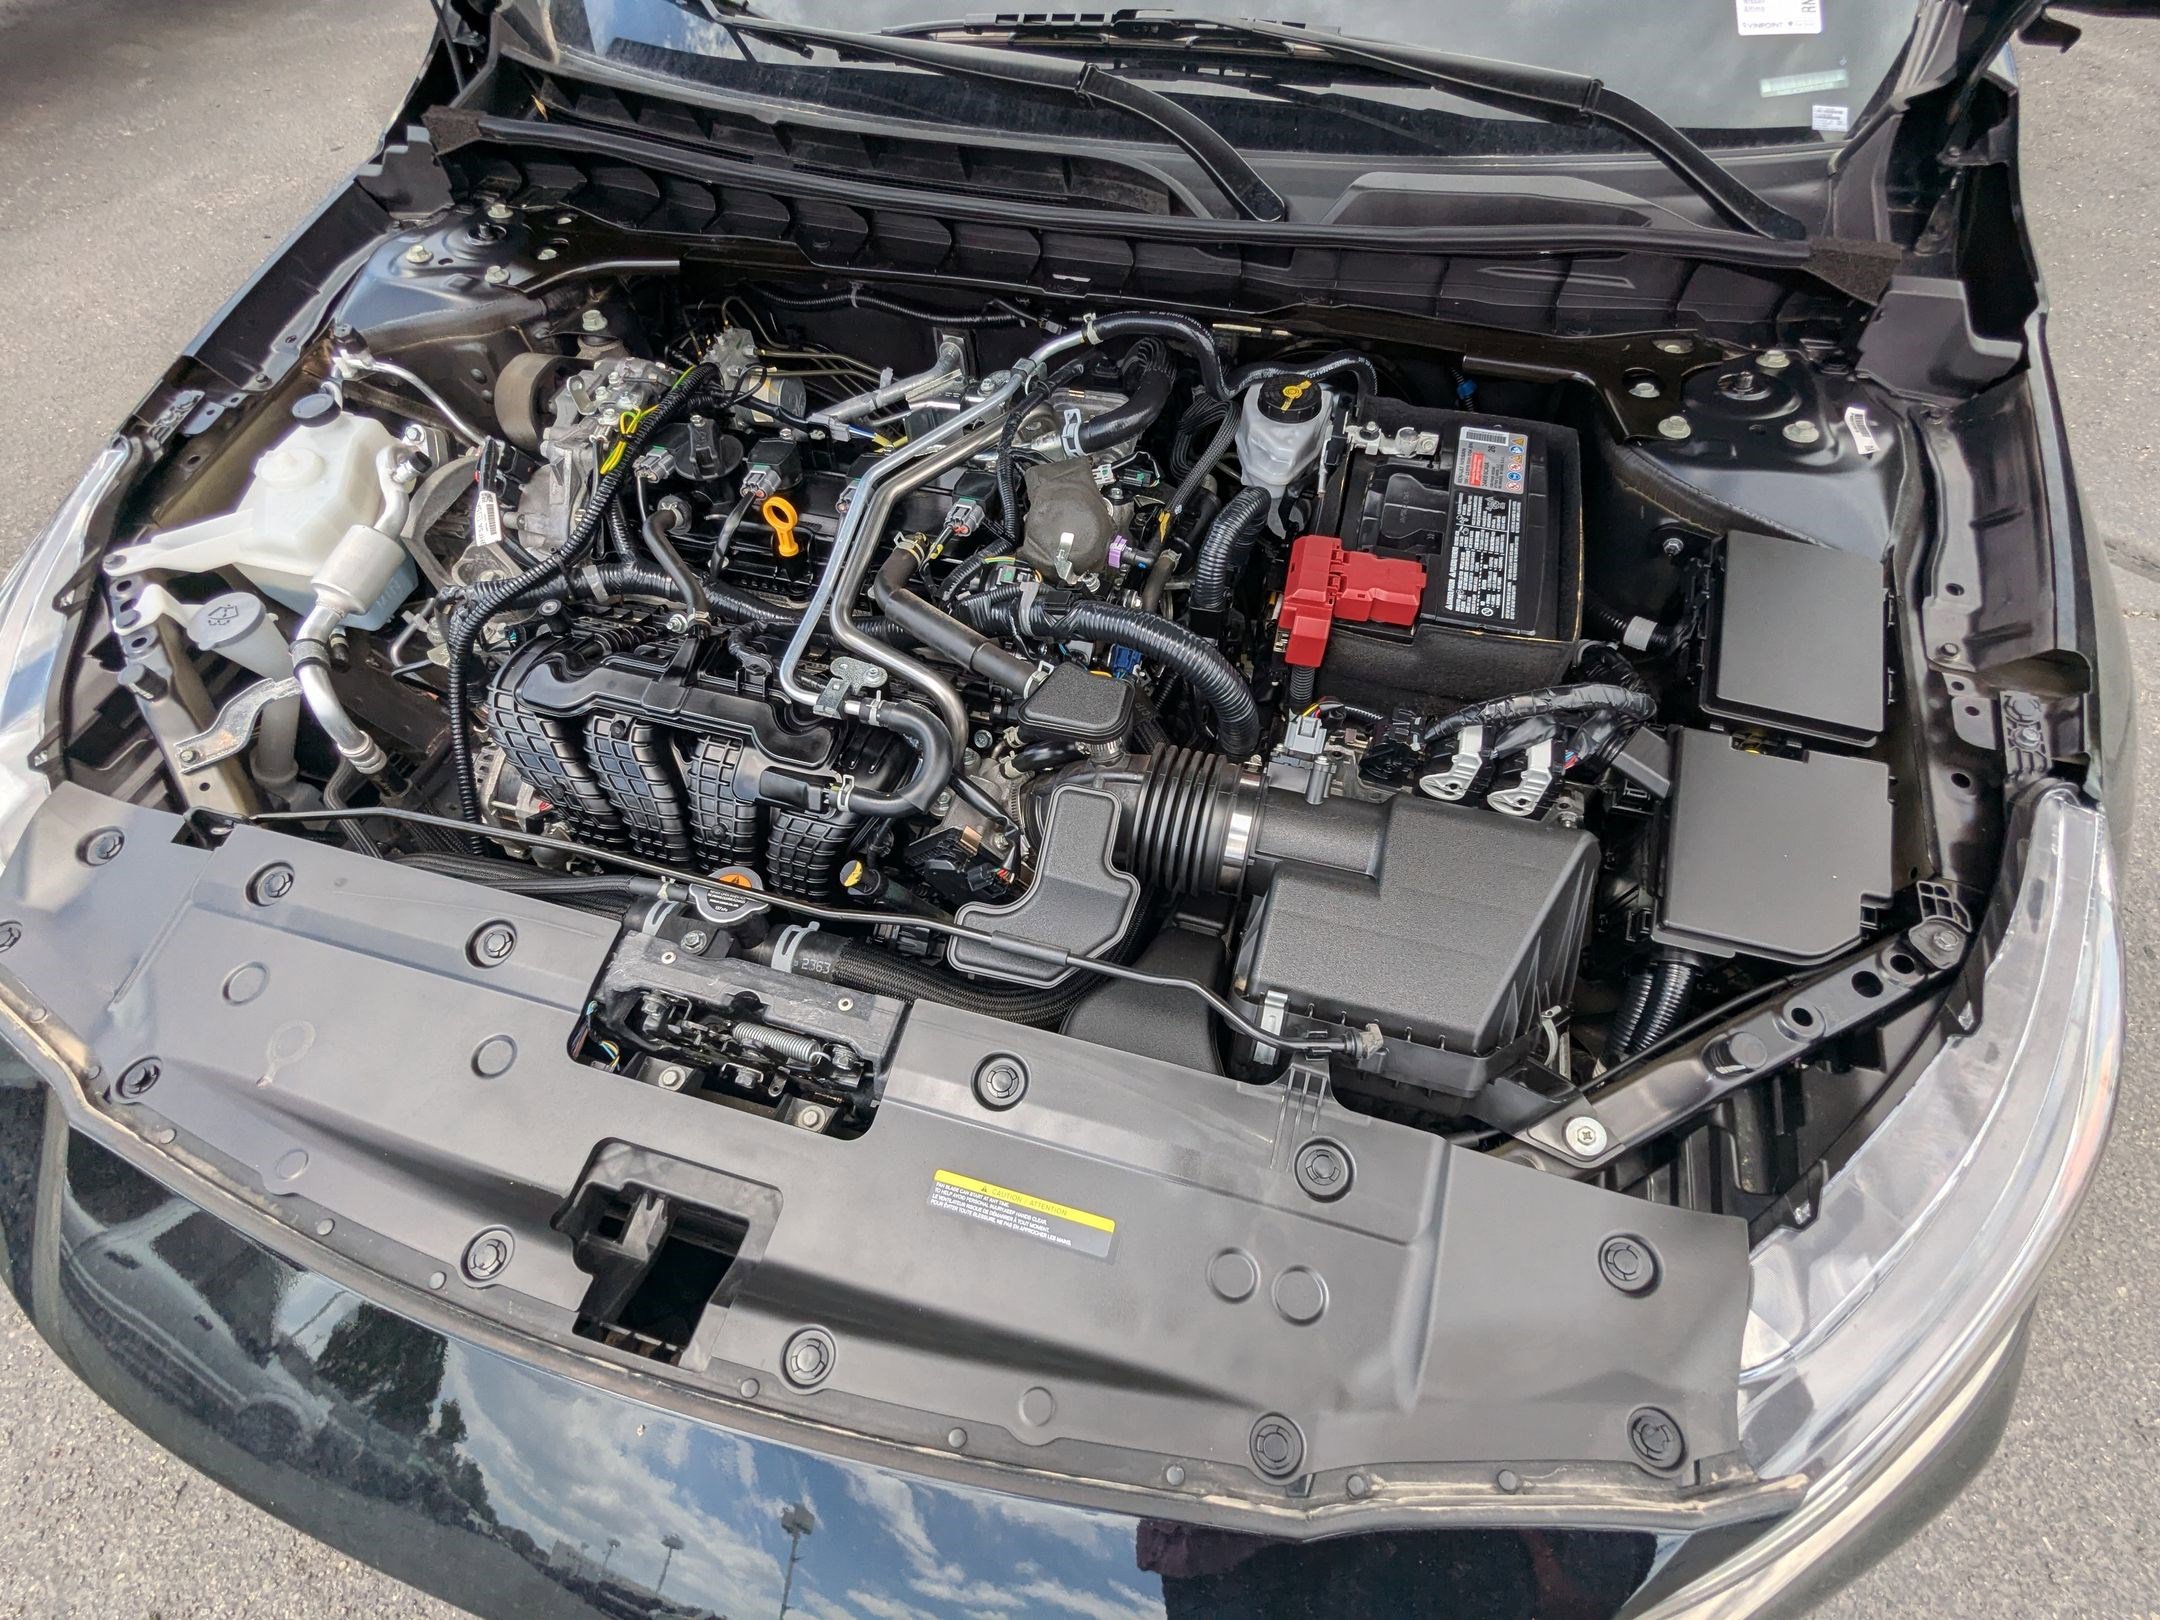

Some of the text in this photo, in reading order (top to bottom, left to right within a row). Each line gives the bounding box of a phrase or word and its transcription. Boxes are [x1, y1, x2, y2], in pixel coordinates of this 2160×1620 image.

[801, 958, 831, 974] 2363
[939, 1195, 965, 1207] VENTILATEUR
[970, 1191, 983, 1199] START
[992, 1188, 1022, 1202] CAUTION
[1029, 1199, 1068, 1216] ATTENTION
[958, 1207, 973, 1216] TOUTE
[966, 1196, 989, 1207] PERSONAL
[1016, 1211, 1031, 1220] HANDS
